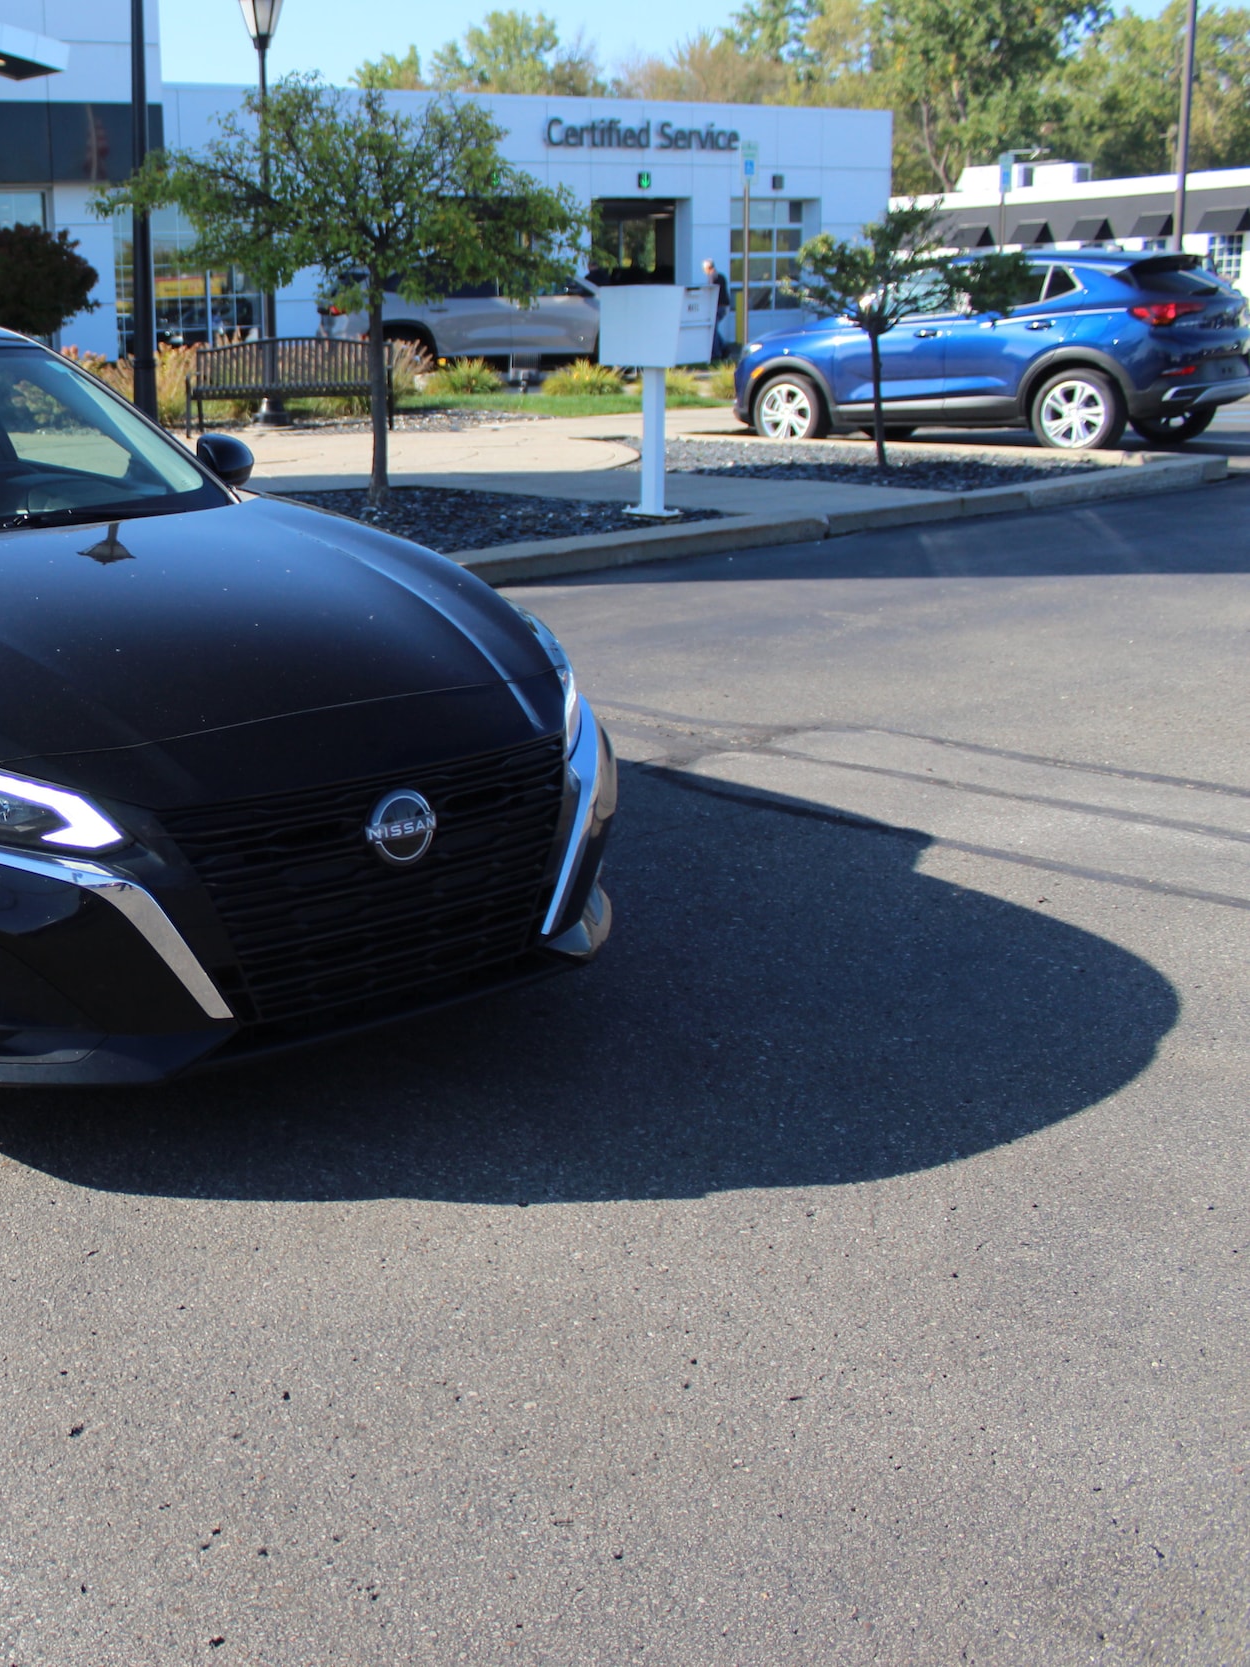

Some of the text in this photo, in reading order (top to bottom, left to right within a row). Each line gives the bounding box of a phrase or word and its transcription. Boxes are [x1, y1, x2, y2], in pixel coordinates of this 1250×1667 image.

[546, 117, 651, 148] Certified
[658, 121, 740, 150] Service
[368, 815, 436, 841] NISSAN
